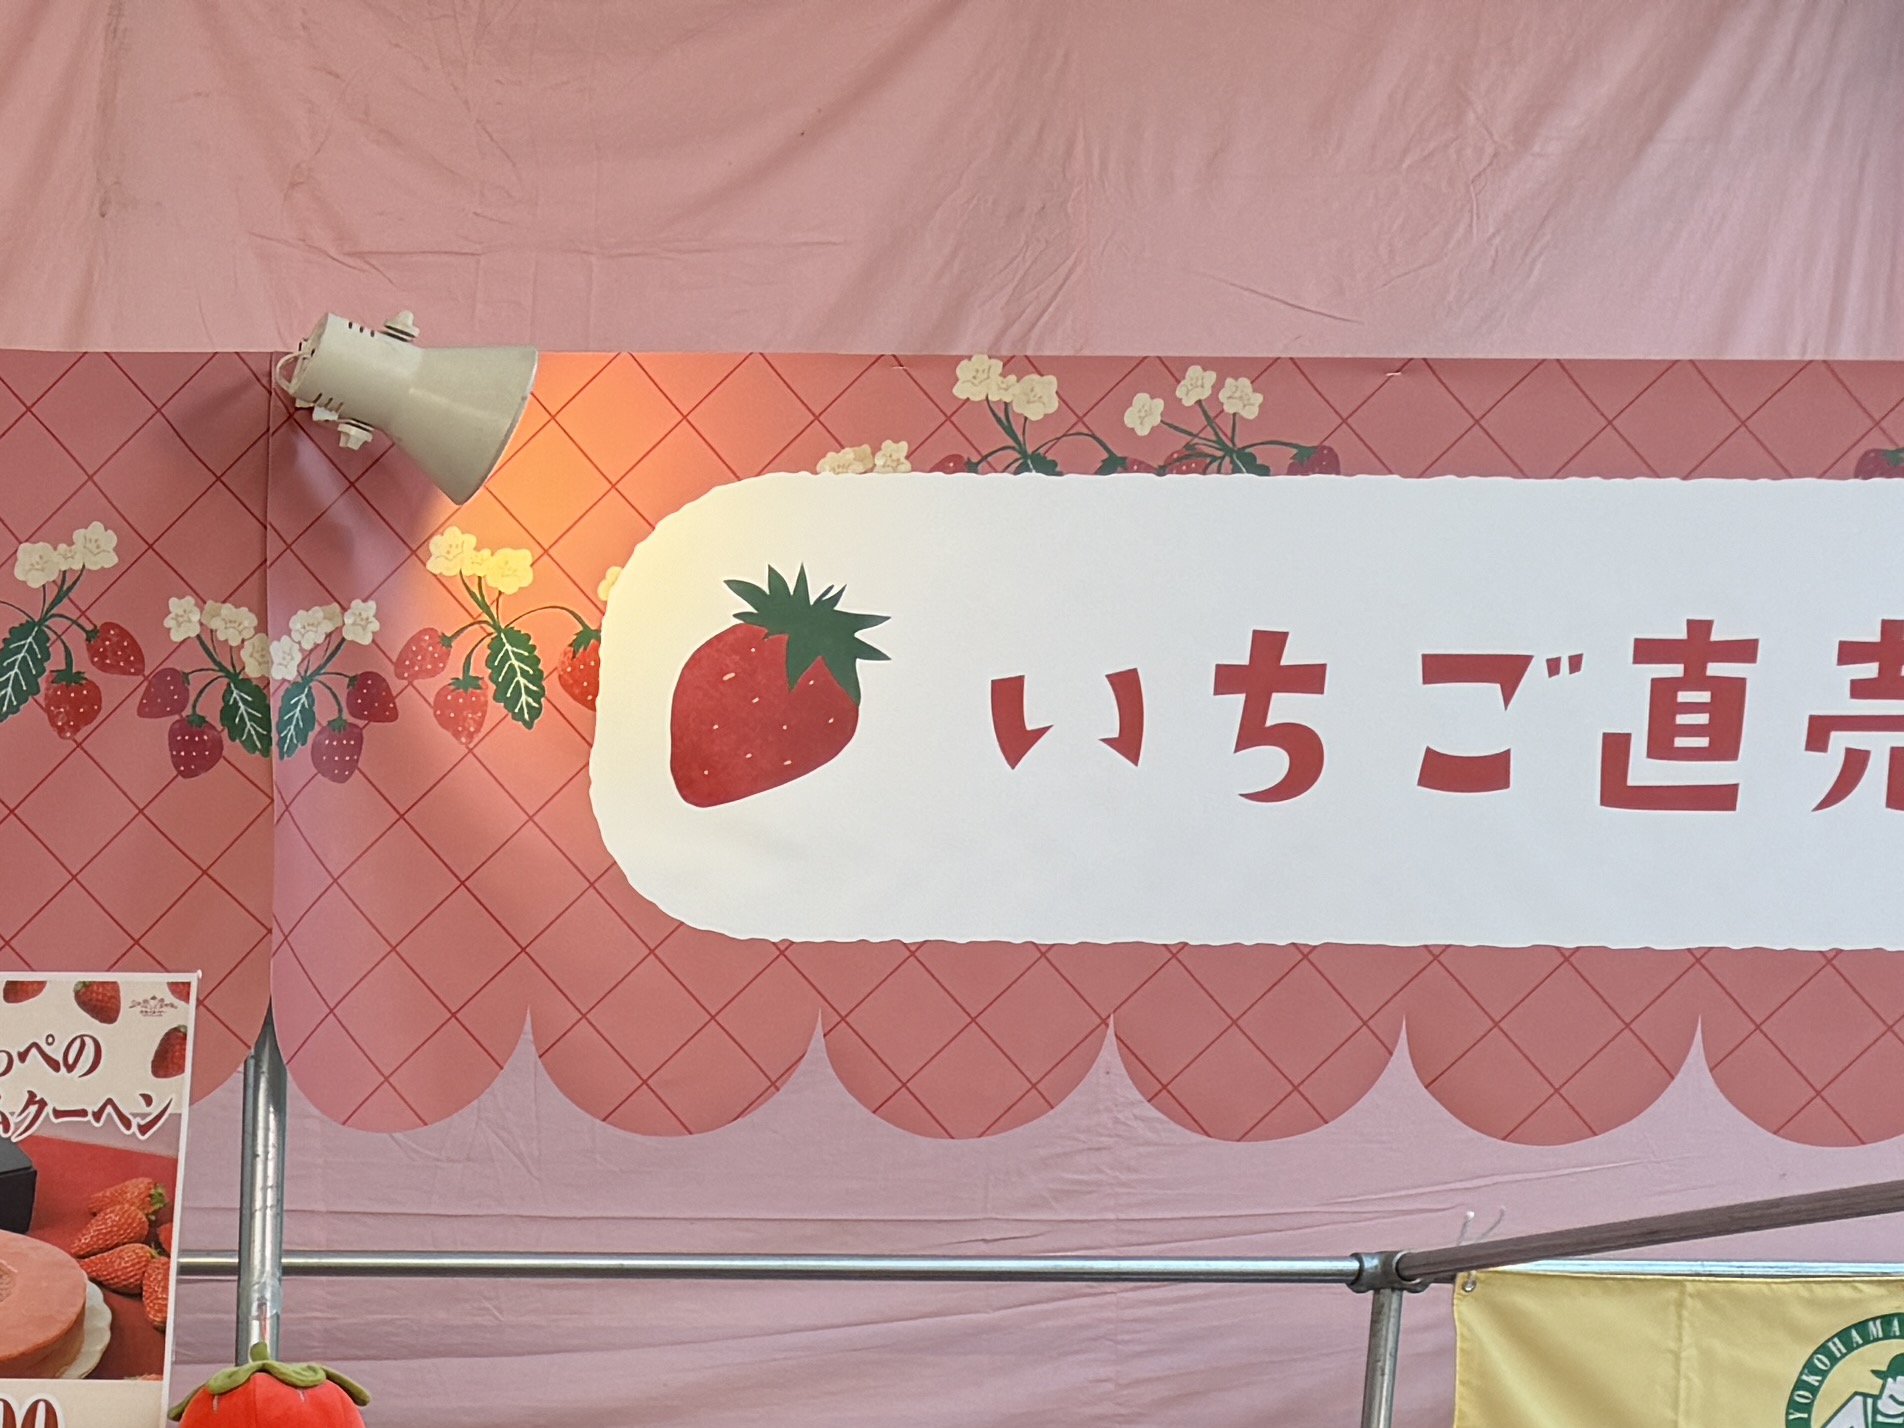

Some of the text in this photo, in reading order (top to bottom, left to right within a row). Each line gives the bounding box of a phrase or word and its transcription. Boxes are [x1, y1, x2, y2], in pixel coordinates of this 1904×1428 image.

[991, 617, 1904, 814] いちご直売
[1789, 1318, 1900, 1420] YOKOHAMA
